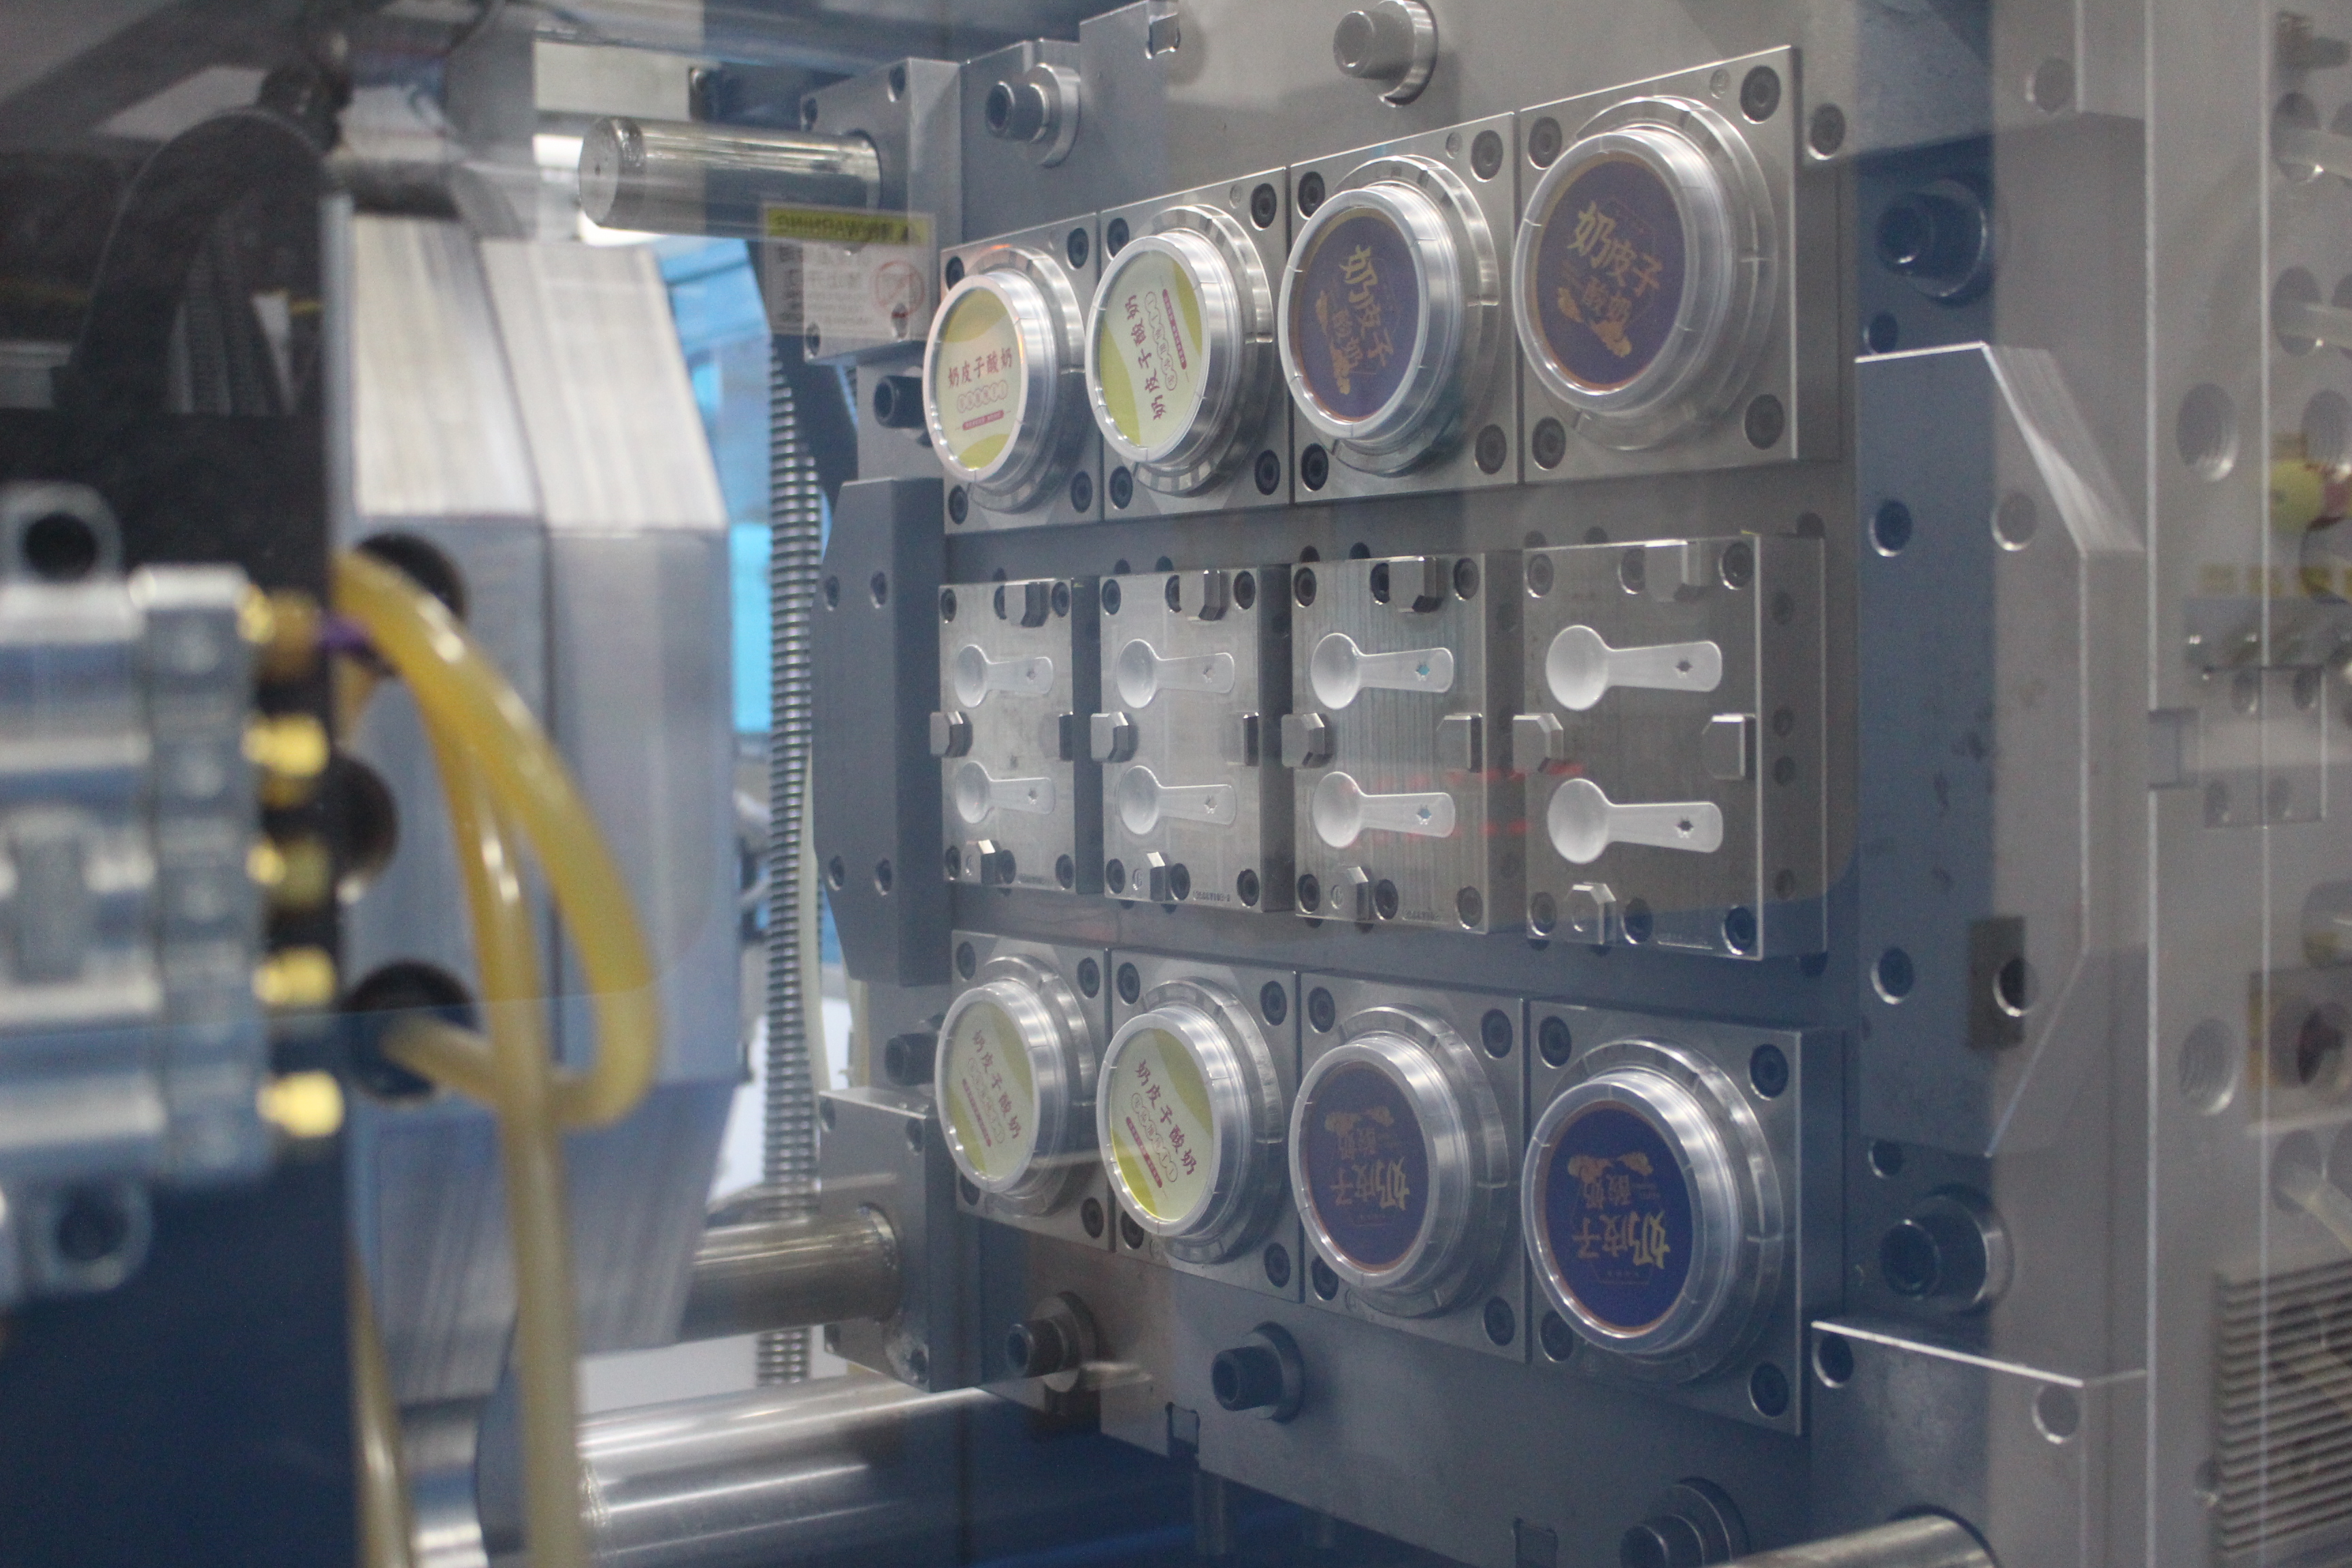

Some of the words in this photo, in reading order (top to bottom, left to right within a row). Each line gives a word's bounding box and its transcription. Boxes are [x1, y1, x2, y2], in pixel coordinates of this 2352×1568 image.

[1567, 201, 1663, 297] 奶皮子
[1125, 295, 1167, 421] 奶皮子酸奶
[1339, 244, 1394, 367] 奶皮子
[947, 347, 1013, 389] 奶皮子酸奶
[1135, 1058, 1197, 1175] 奶皮子酸奶
[1572, 1209, 1671, 1270] 奶皮子
